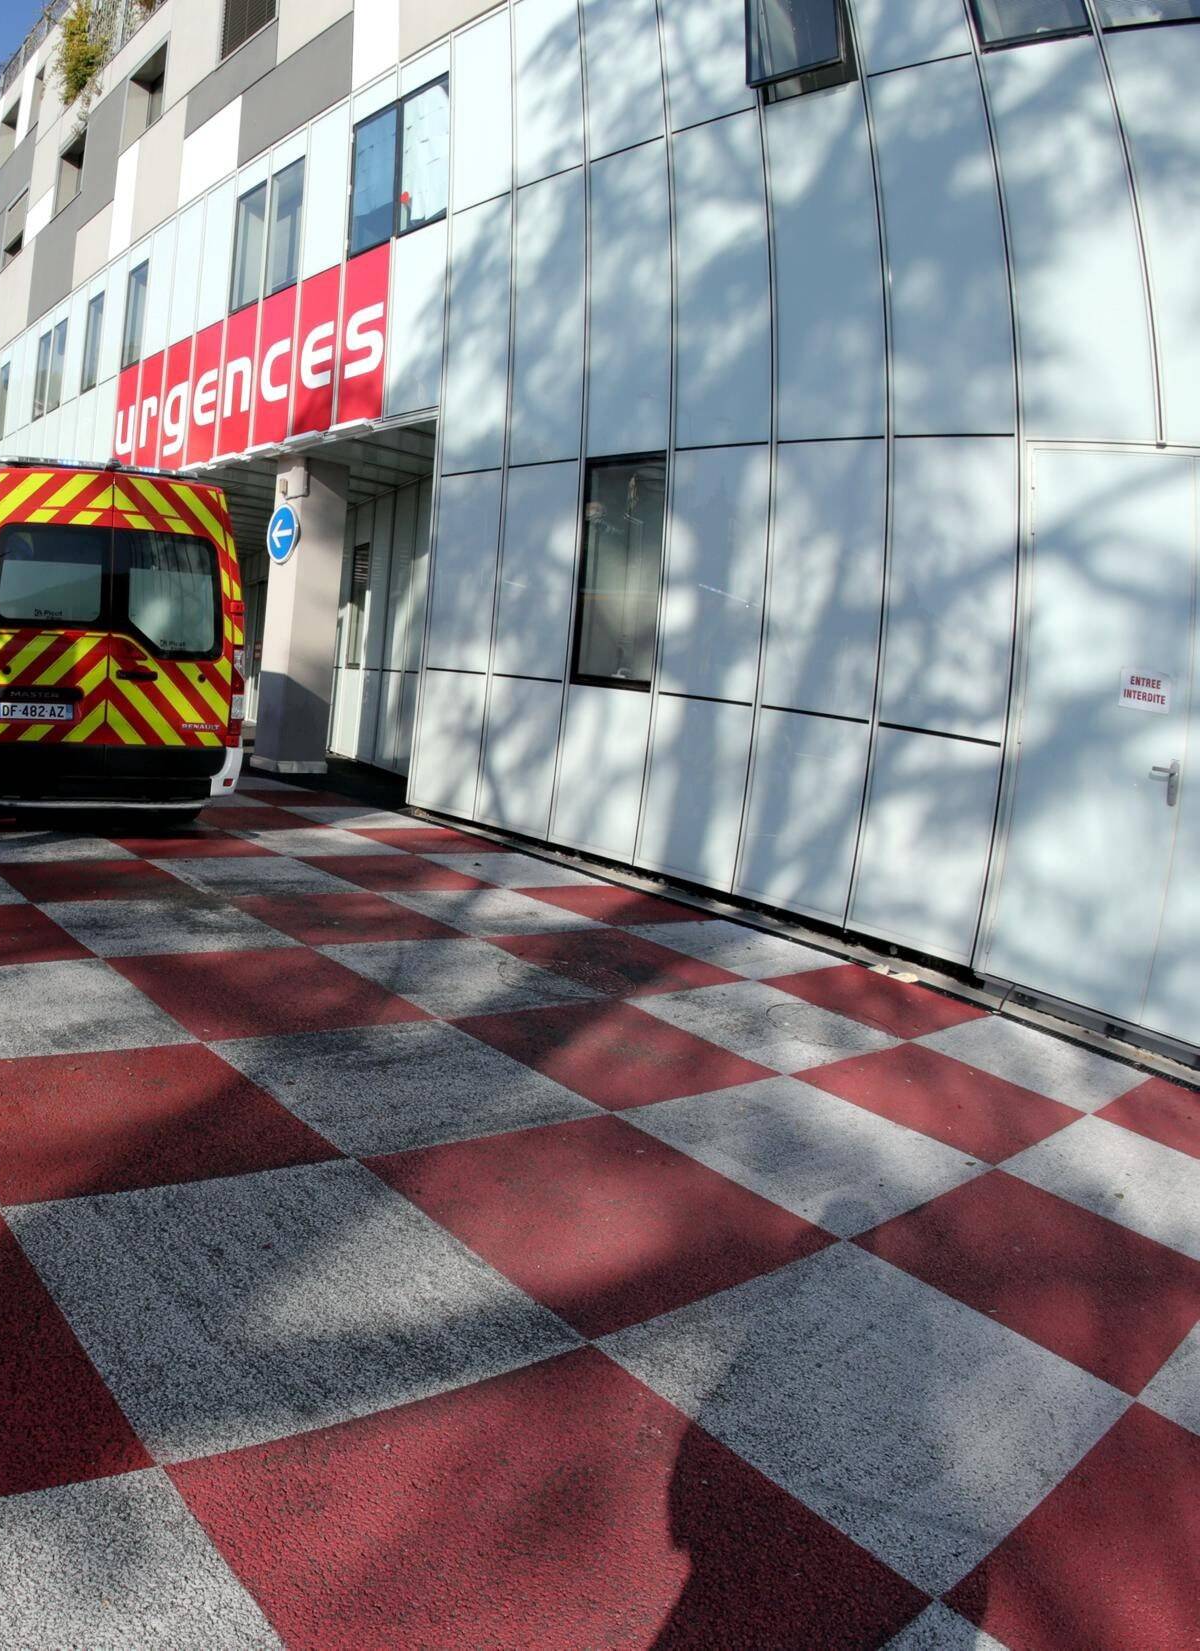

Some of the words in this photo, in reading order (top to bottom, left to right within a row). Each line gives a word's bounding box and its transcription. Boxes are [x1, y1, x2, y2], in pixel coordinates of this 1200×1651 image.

[115, 301, 384, 457] urgences
[1130, 675, 1162, 689] ENTREE
[10, 690, 59, 698] MASTER
[1123, 689, 1166, 705] INTERDITE
